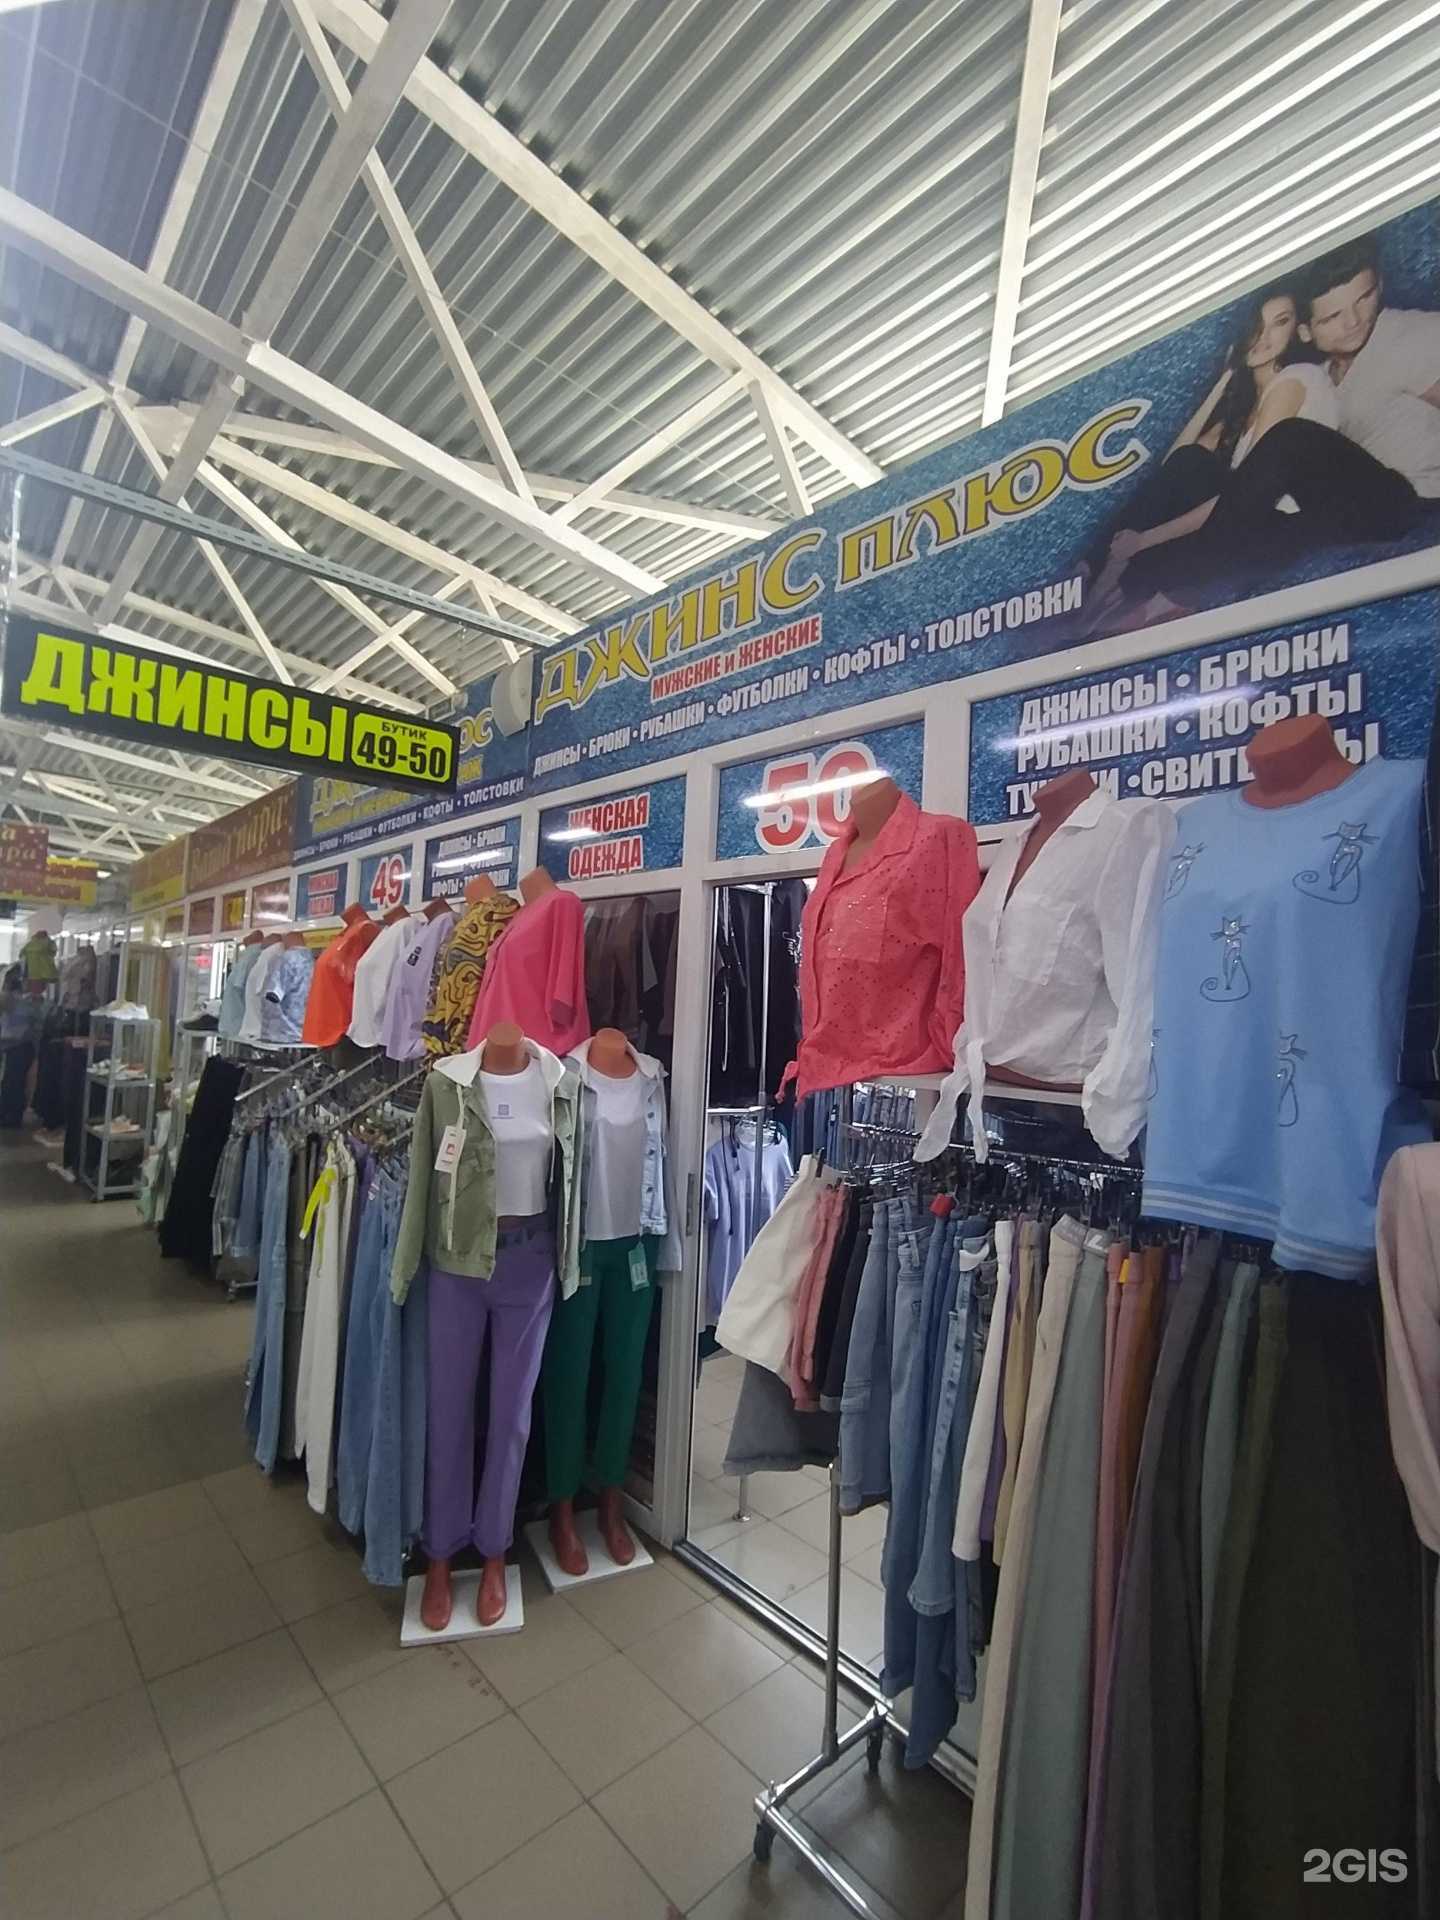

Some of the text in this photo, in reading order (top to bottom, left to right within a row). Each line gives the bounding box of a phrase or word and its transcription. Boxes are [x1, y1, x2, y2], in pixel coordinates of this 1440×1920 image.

[534, 402, 1147, 724] ДЖИНС ПЛЮС
[21, 632, 348, 762] ДЖИНСЫ
[589, 727, 630, 758] БРЮКИ
[640, 701, 705, 742] РУБАШКИ
[717, 666, 808, 716] ФУТБОЛКИ
[824, 634, 905, 684] КОФТЫ
[925, 577, 1082, 652] ТОЛСТОВКИ
[653, 652, 721, 700] МУЖСКИЕ
[738, 617, 821, 668] ЖЕНСКИЕ
[1020, 624, 1349, 736] ДЖИНСЫ БРЮКИ
[357, 731, 446, 778] 49-50
[381, 721, 427, 740] БУТИК
[1017, 673, 1362, 774] РУБАШКИ КОФТЫ
[423, 800, 454, 819] КОФТЫ
[463, 776, 524, 807] ТОЛСТОВКИ
[569, 795, 649, 832] ЖЕНСКАЯ
[758, 745, 873, 850] 50
[371, 855, 404, 905] 49
[569, 837, 642, 878] ОДЕЖДА
